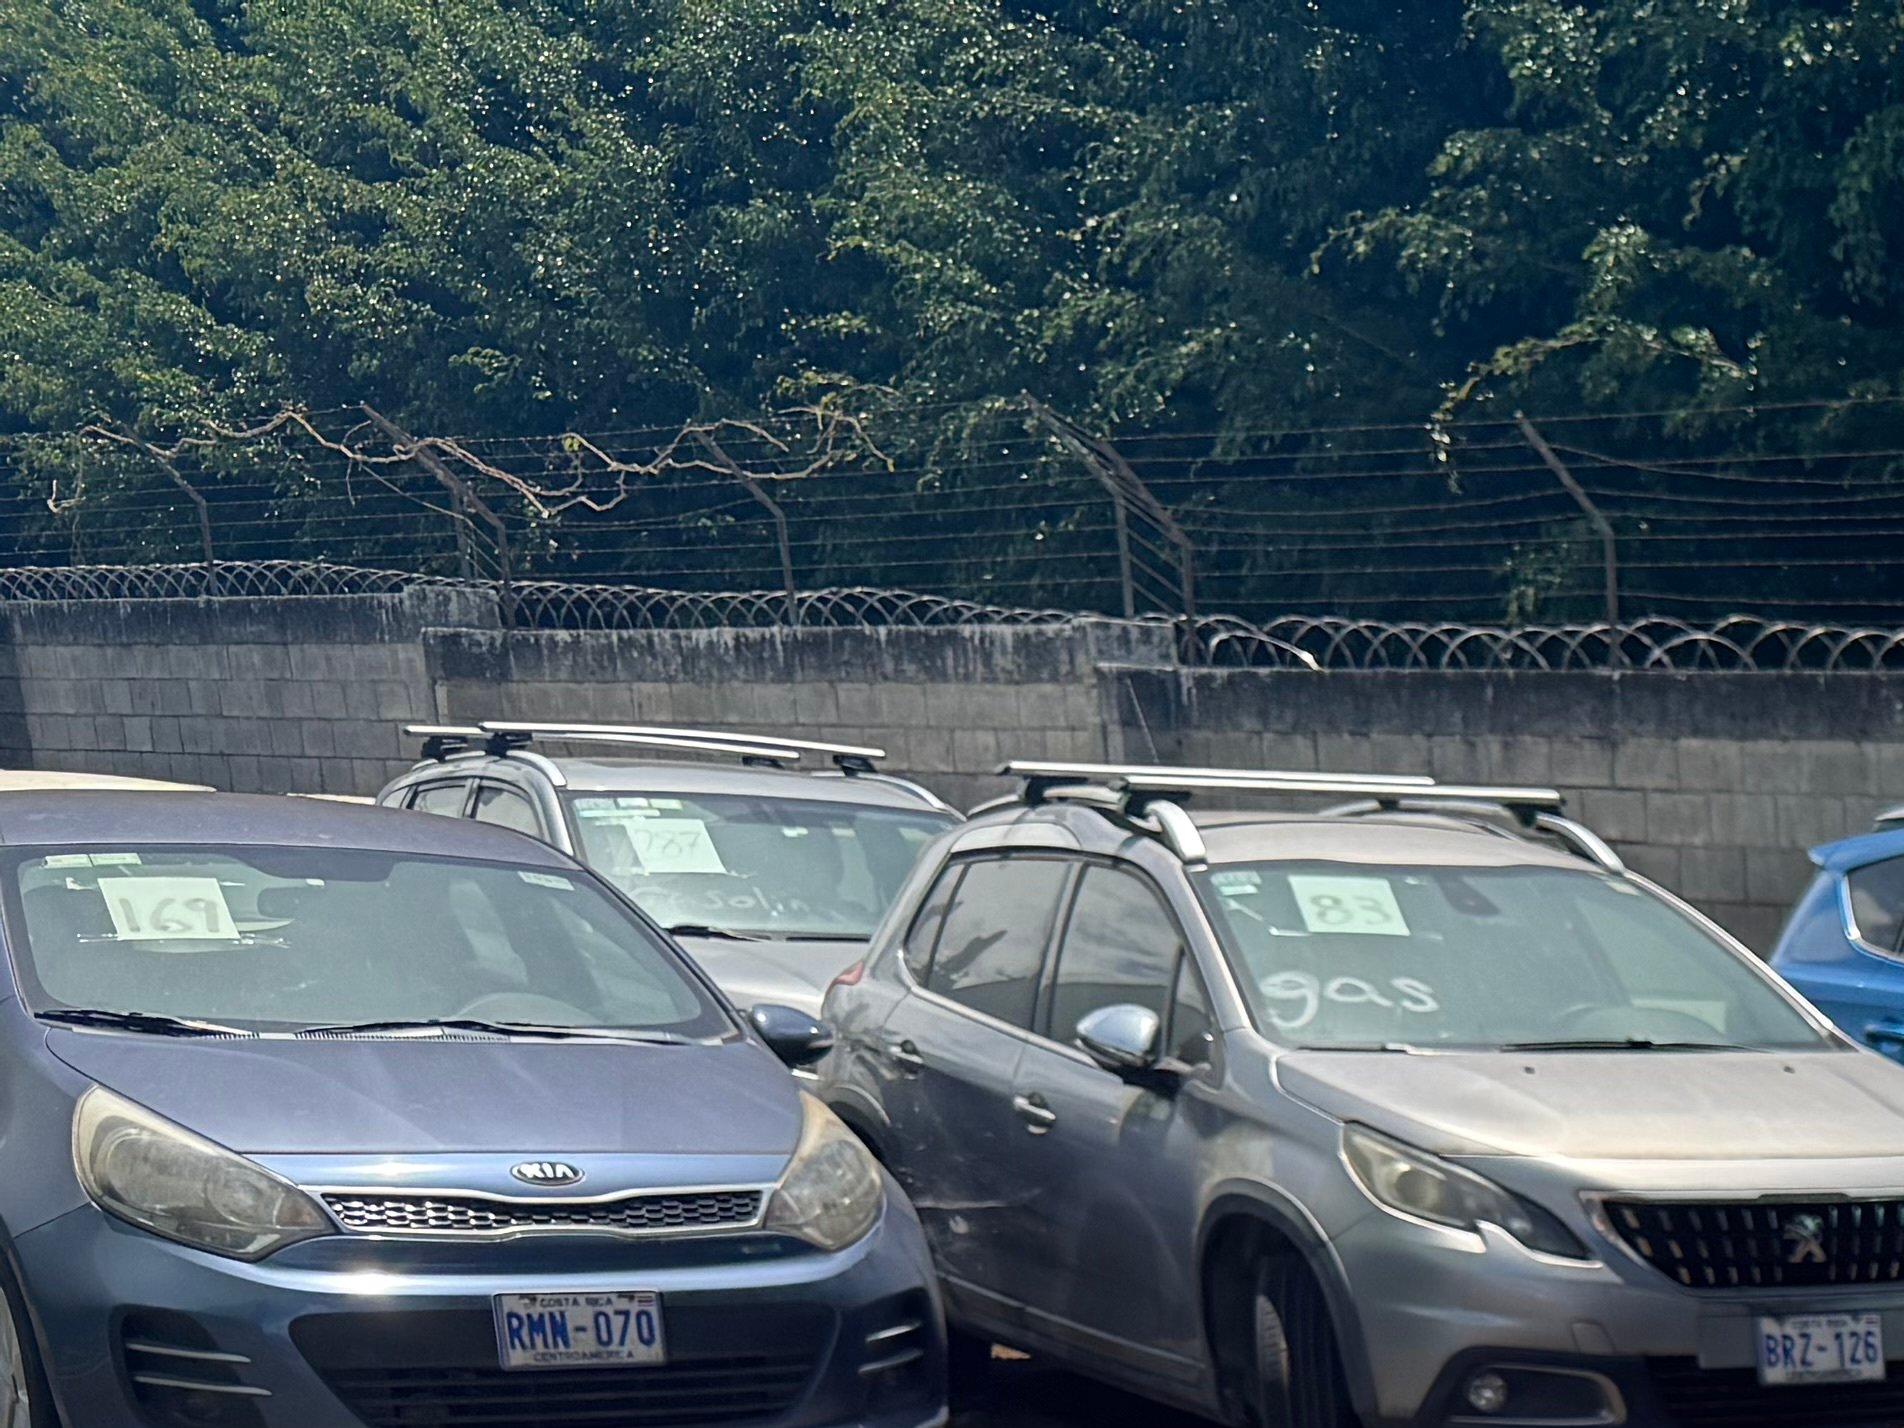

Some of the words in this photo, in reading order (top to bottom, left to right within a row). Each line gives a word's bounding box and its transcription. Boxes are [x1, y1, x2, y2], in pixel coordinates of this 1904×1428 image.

[118, 897, 220, 933] 169
[1310, 894, 1392, 925] 83
[1259, 970, 1440, 1027] gas
[517, 1162, 574, 1179] KIA
[506, 1310, 656, 1350] RMN-070
[1764, 1331, 1877, 1368] BRZ-126
